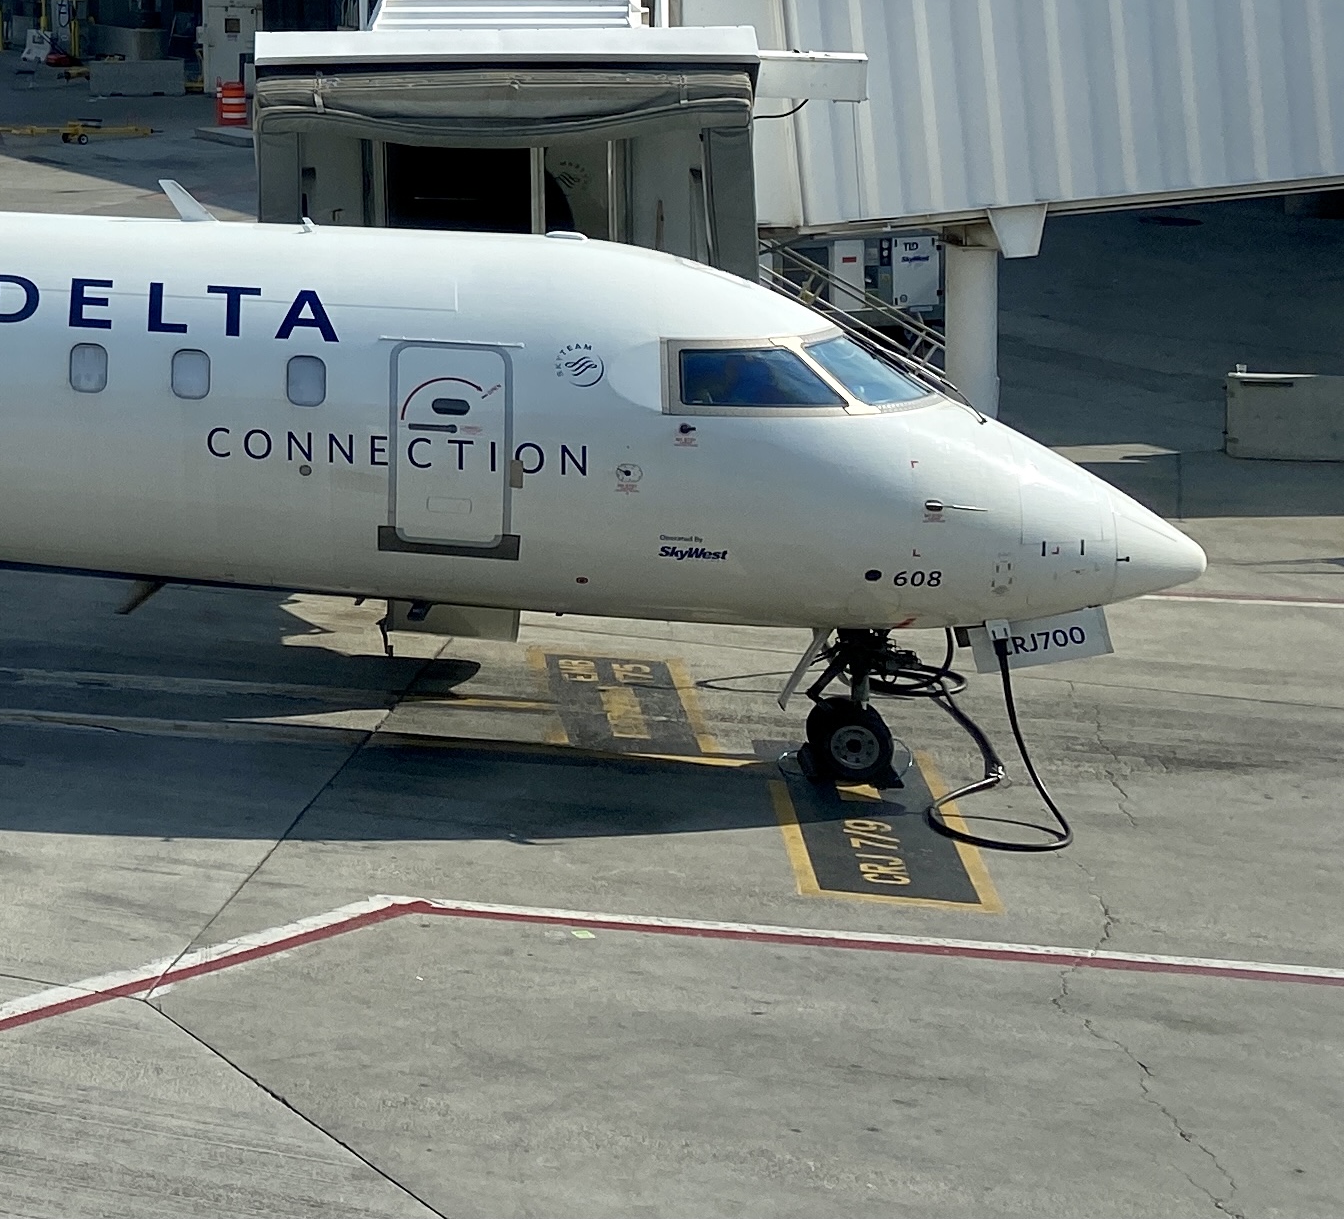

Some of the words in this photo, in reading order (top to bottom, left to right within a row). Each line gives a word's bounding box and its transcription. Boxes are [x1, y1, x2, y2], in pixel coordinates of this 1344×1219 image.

[903, 241, 919, 251] TLD
[554, 343, 593, 377] SKYTEAM
[206, 427, 588, 477] CONNECTION
[658, 545, 728, 561] SkyWest
[893, 570, 942, 587] 608
[1006, 626, 1086, 656] RJ700
[843, 819, 901, 850] 7/9
[856, 852, 912, 885] CRJ
